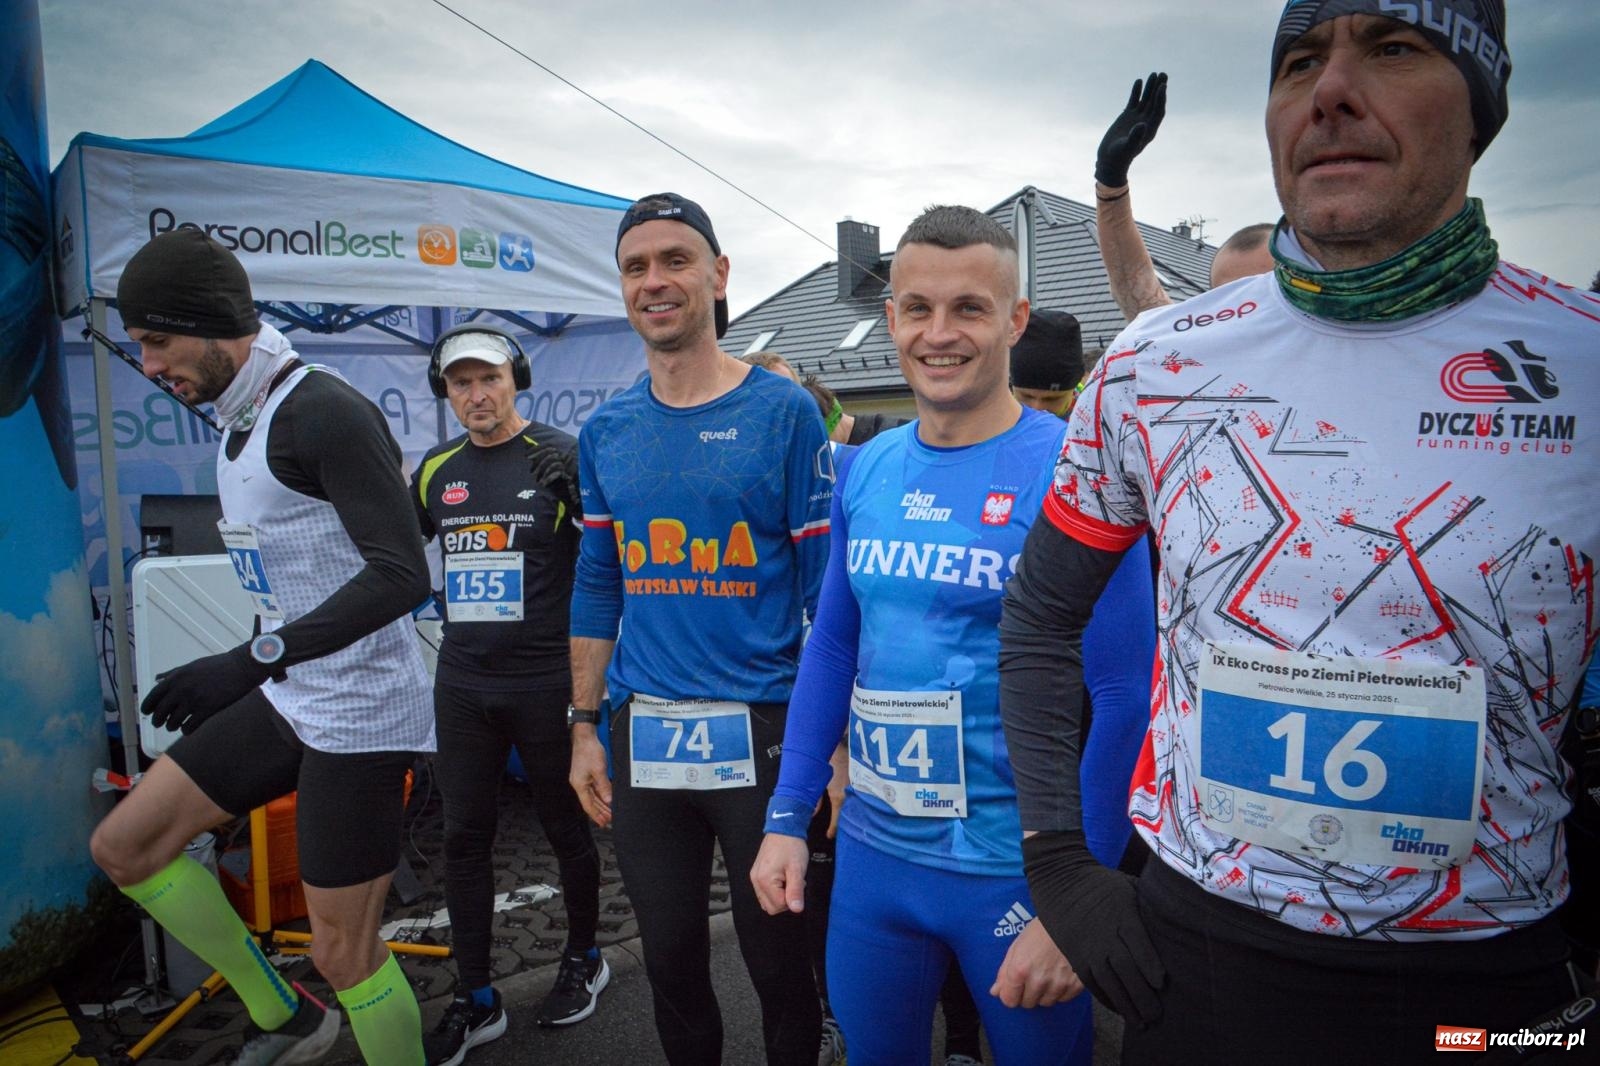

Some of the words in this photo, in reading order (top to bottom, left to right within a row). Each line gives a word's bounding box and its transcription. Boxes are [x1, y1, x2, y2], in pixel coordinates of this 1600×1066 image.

[149, 207, 405, 259] PrsonalBest
[1173, 301, 1257, 332] deep
[699, 428, 739, 443] quest
[1418, 406, 1504, 437] DYCZUŚ
[1511, 413, 1576, 440] TEAM
[1416, 437, 1511, 455] running
[1520, 440, 1573, 454] club
[517, 490, 536, 500] 4F
[441, 515, 490, 527] ENERGETYKA
[492, 514, 534, 523] SOLARNA
[456, 571, 506, 600] 155
[701, 575, 757, 599] ŚLĄSKI
[1212, 654, 1226, 667] IX
[1227, 657, 1249, 670] Eko
[1251, 661, 1290, 676] Cross
[1291, 667, 1310, 680] po
[1311, 668, 1356, 683] Ziemi
[1357, 671, 1462, 694] Pietrowickiej
[869, 698, 891, 708] Ziemi
[892, 699, 949, 710] Pietrowickiej
[1258, 682, 1295, 694] Pietrowice
[1296, 687, 1325, 698] Wielkie,
[1338, 692, 1371, 702] stycznia
[1373, 695, 1393, 703] 2025
[662, 720, 714, 760] 74
[854, 720, 934, 779] 114
[1266, 711, 1388, 801] 16
[993, 921, 1026, 937] adid
